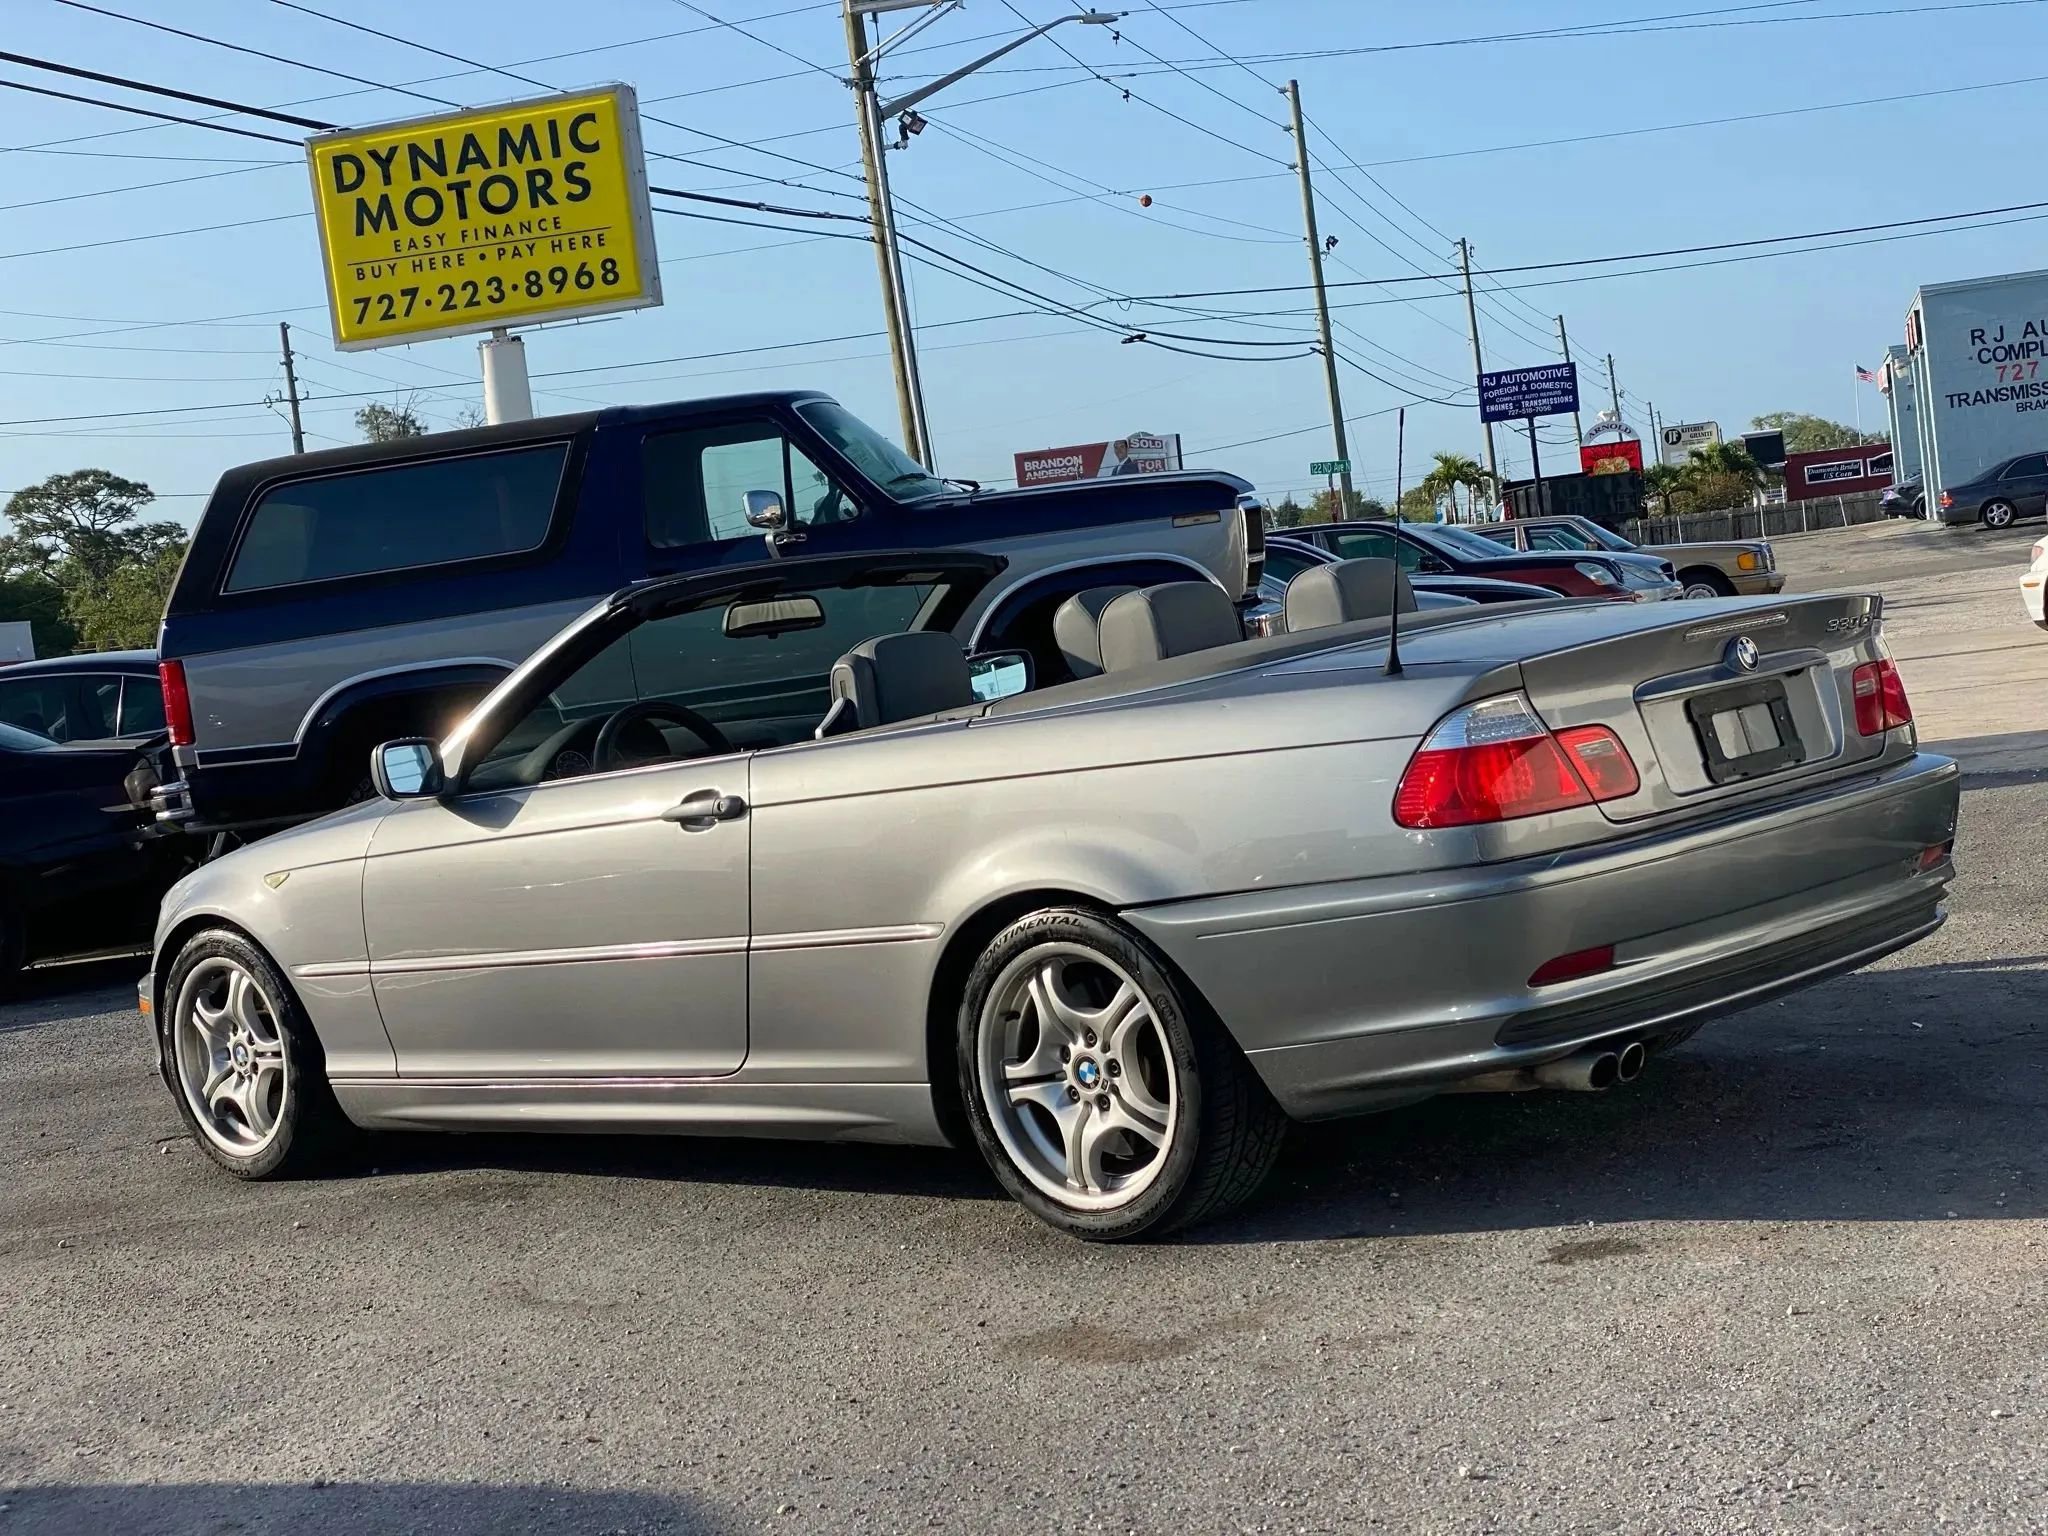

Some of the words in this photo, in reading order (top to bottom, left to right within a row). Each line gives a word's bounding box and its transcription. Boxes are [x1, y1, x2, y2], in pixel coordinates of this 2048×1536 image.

[332, 113, 600, 193] DYNAMIC
[355, 162, 592, 236] MOTORS
[394, 233, 446, 252] EASY
[461, 217, 562, 243] FINANCE
[357, 263, 399, 281] BUY
[412, 253, 465, 273] HERE
[497, 243, 536, 261] PAY
[551, 233, 606, 254] HERE
[1977, 340, 2048, 364] COMPL
[1482, 377, 1496, 387] RJ
[1500, 367, 1570, 384] AUTOMOTIVE
[1995, 361, 2039, 383] 727
[1483, 385, 1519, 399] FOREIGN
[1521, 383, 1528, 391] &
[1530, 381, 1573, 390] DOMESTIC
[1495, 395, 1524, 403] COMPLETE
[1486, 402, 1514, 413] ENGINES
[1521, 395, 1573, 408] TRANSMISSIONS
[1588, 423, 1632, 438] ARNOLD
[1130, 438, 1162, 449] SOLD
[1024, 455, 1083, 471] BRANDON
[1025, 465, 1084, 480] ANDERSON
[1138, 459, 1163, 470] FOR
[979, 916, 1081, 967] ONTINENTAL
